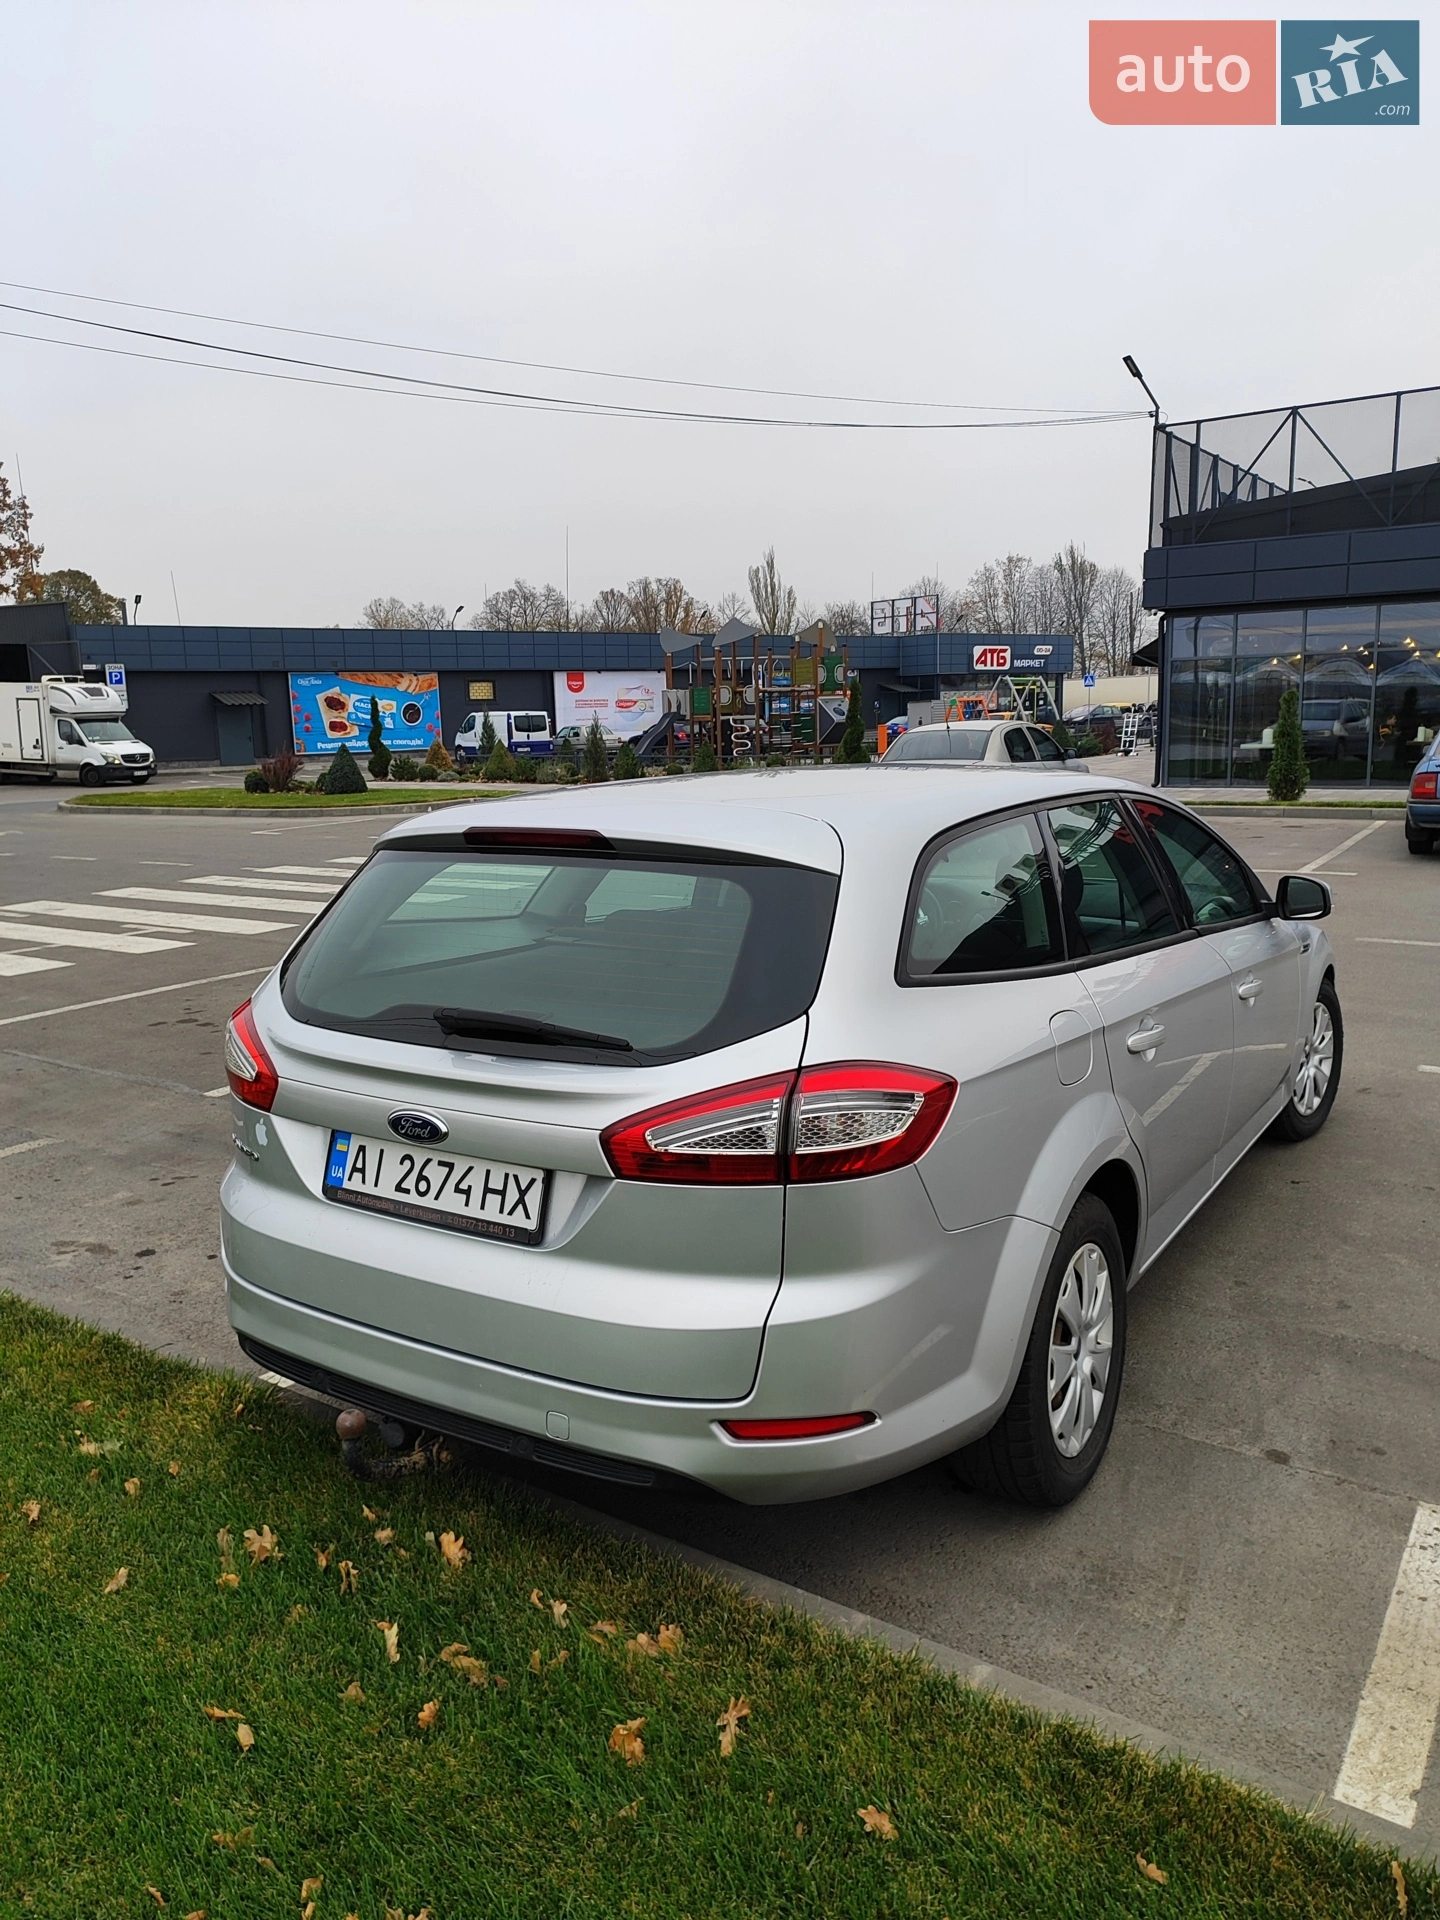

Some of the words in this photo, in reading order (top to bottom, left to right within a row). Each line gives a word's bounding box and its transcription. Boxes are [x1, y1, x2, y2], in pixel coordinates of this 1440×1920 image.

[975, 648, 1009, 667] АТБ
[1013, 659, 1046, 668] МАРКЕТ
[398, 1117, 431, 1138] Ford
[331, 1164, 343, 1179] UA
[356, 1194, 395, 1211] Automobile
[400, 1204, 441, 1221] Leverkusen
